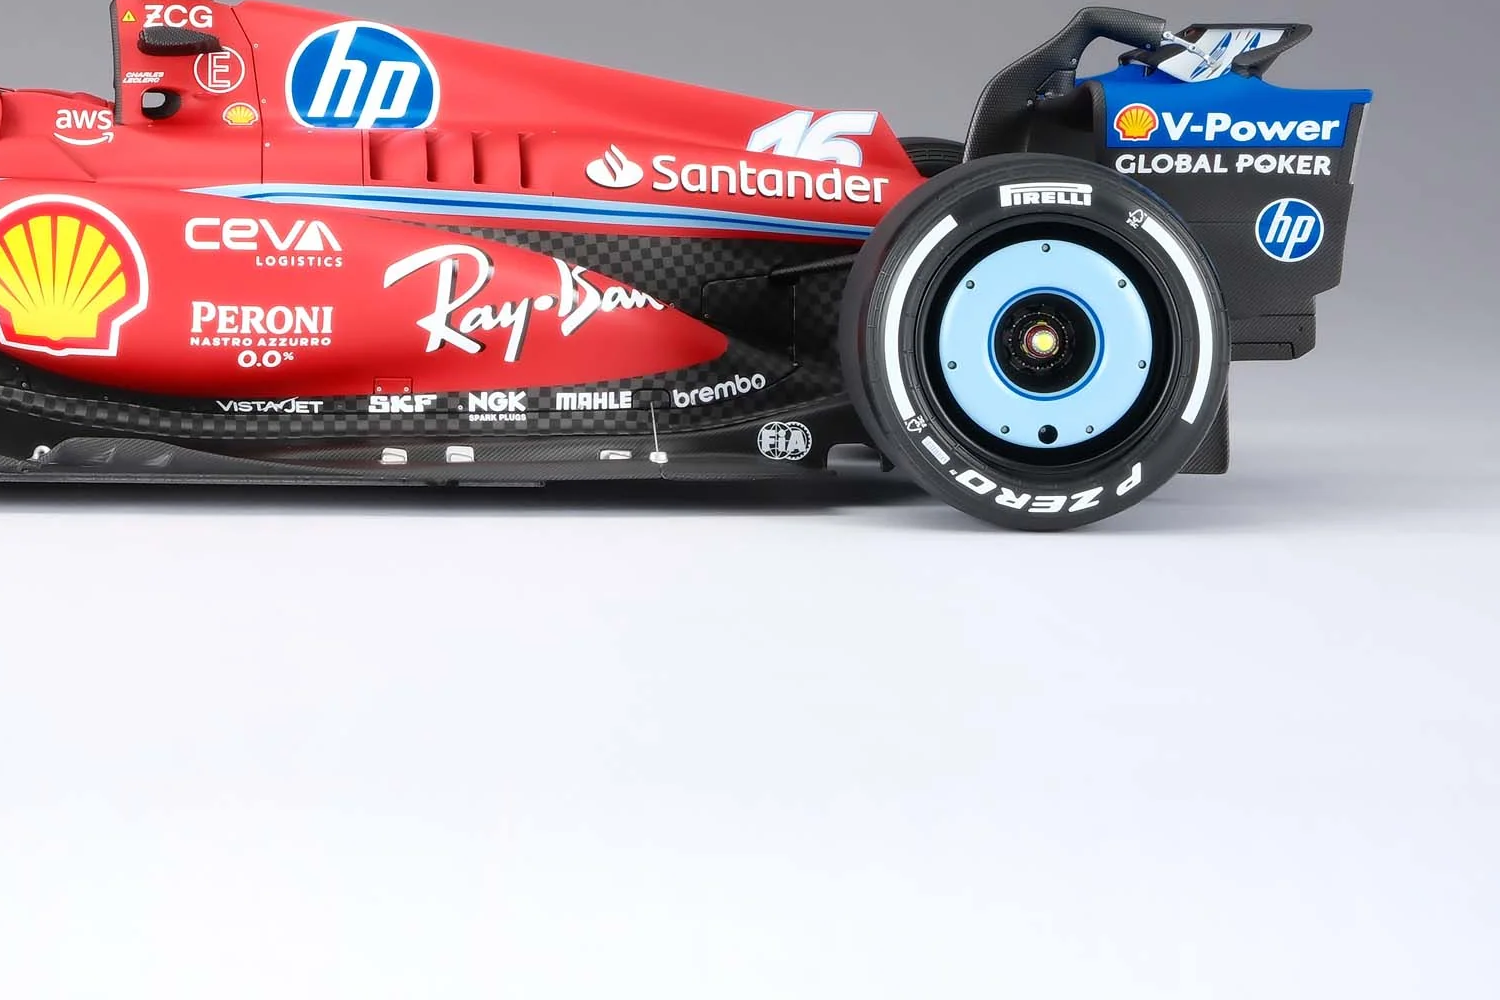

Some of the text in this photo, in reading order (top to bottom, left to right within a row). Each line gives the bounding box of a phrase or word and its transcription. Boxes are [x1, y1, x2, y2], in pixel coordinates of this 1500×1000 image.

[143, 4, 213, 28] ZCG
[307, 22, 421, 129] hp
[55, 109, 113, 130] aws
[1161, 112, 1340, 142] V-Power
[746, 110, 878, 168] 16
[1115, 154, 1331, 176] GLOBAL POKER
[651, 155, 889, 203] Santander
[1000, 181, 1093, 208] PIRELLI
[1265, 199, 1316, 261] hp
[256, 256, 343, 267] LOGISTICS
[190, 301, 334, 334] PERONI
[190, 337, 331, 347] NASTRO AZZURRO
[468, 391, 527, 412] NGK
[556, 391, 632, 410] MAHLE
[672, 373, 767, 408] brembo
[368, 395, 437, 413] SKF
[469, 413, 527, 422] SPARK PLUGS
[1116, 462, 1142, 496] P
